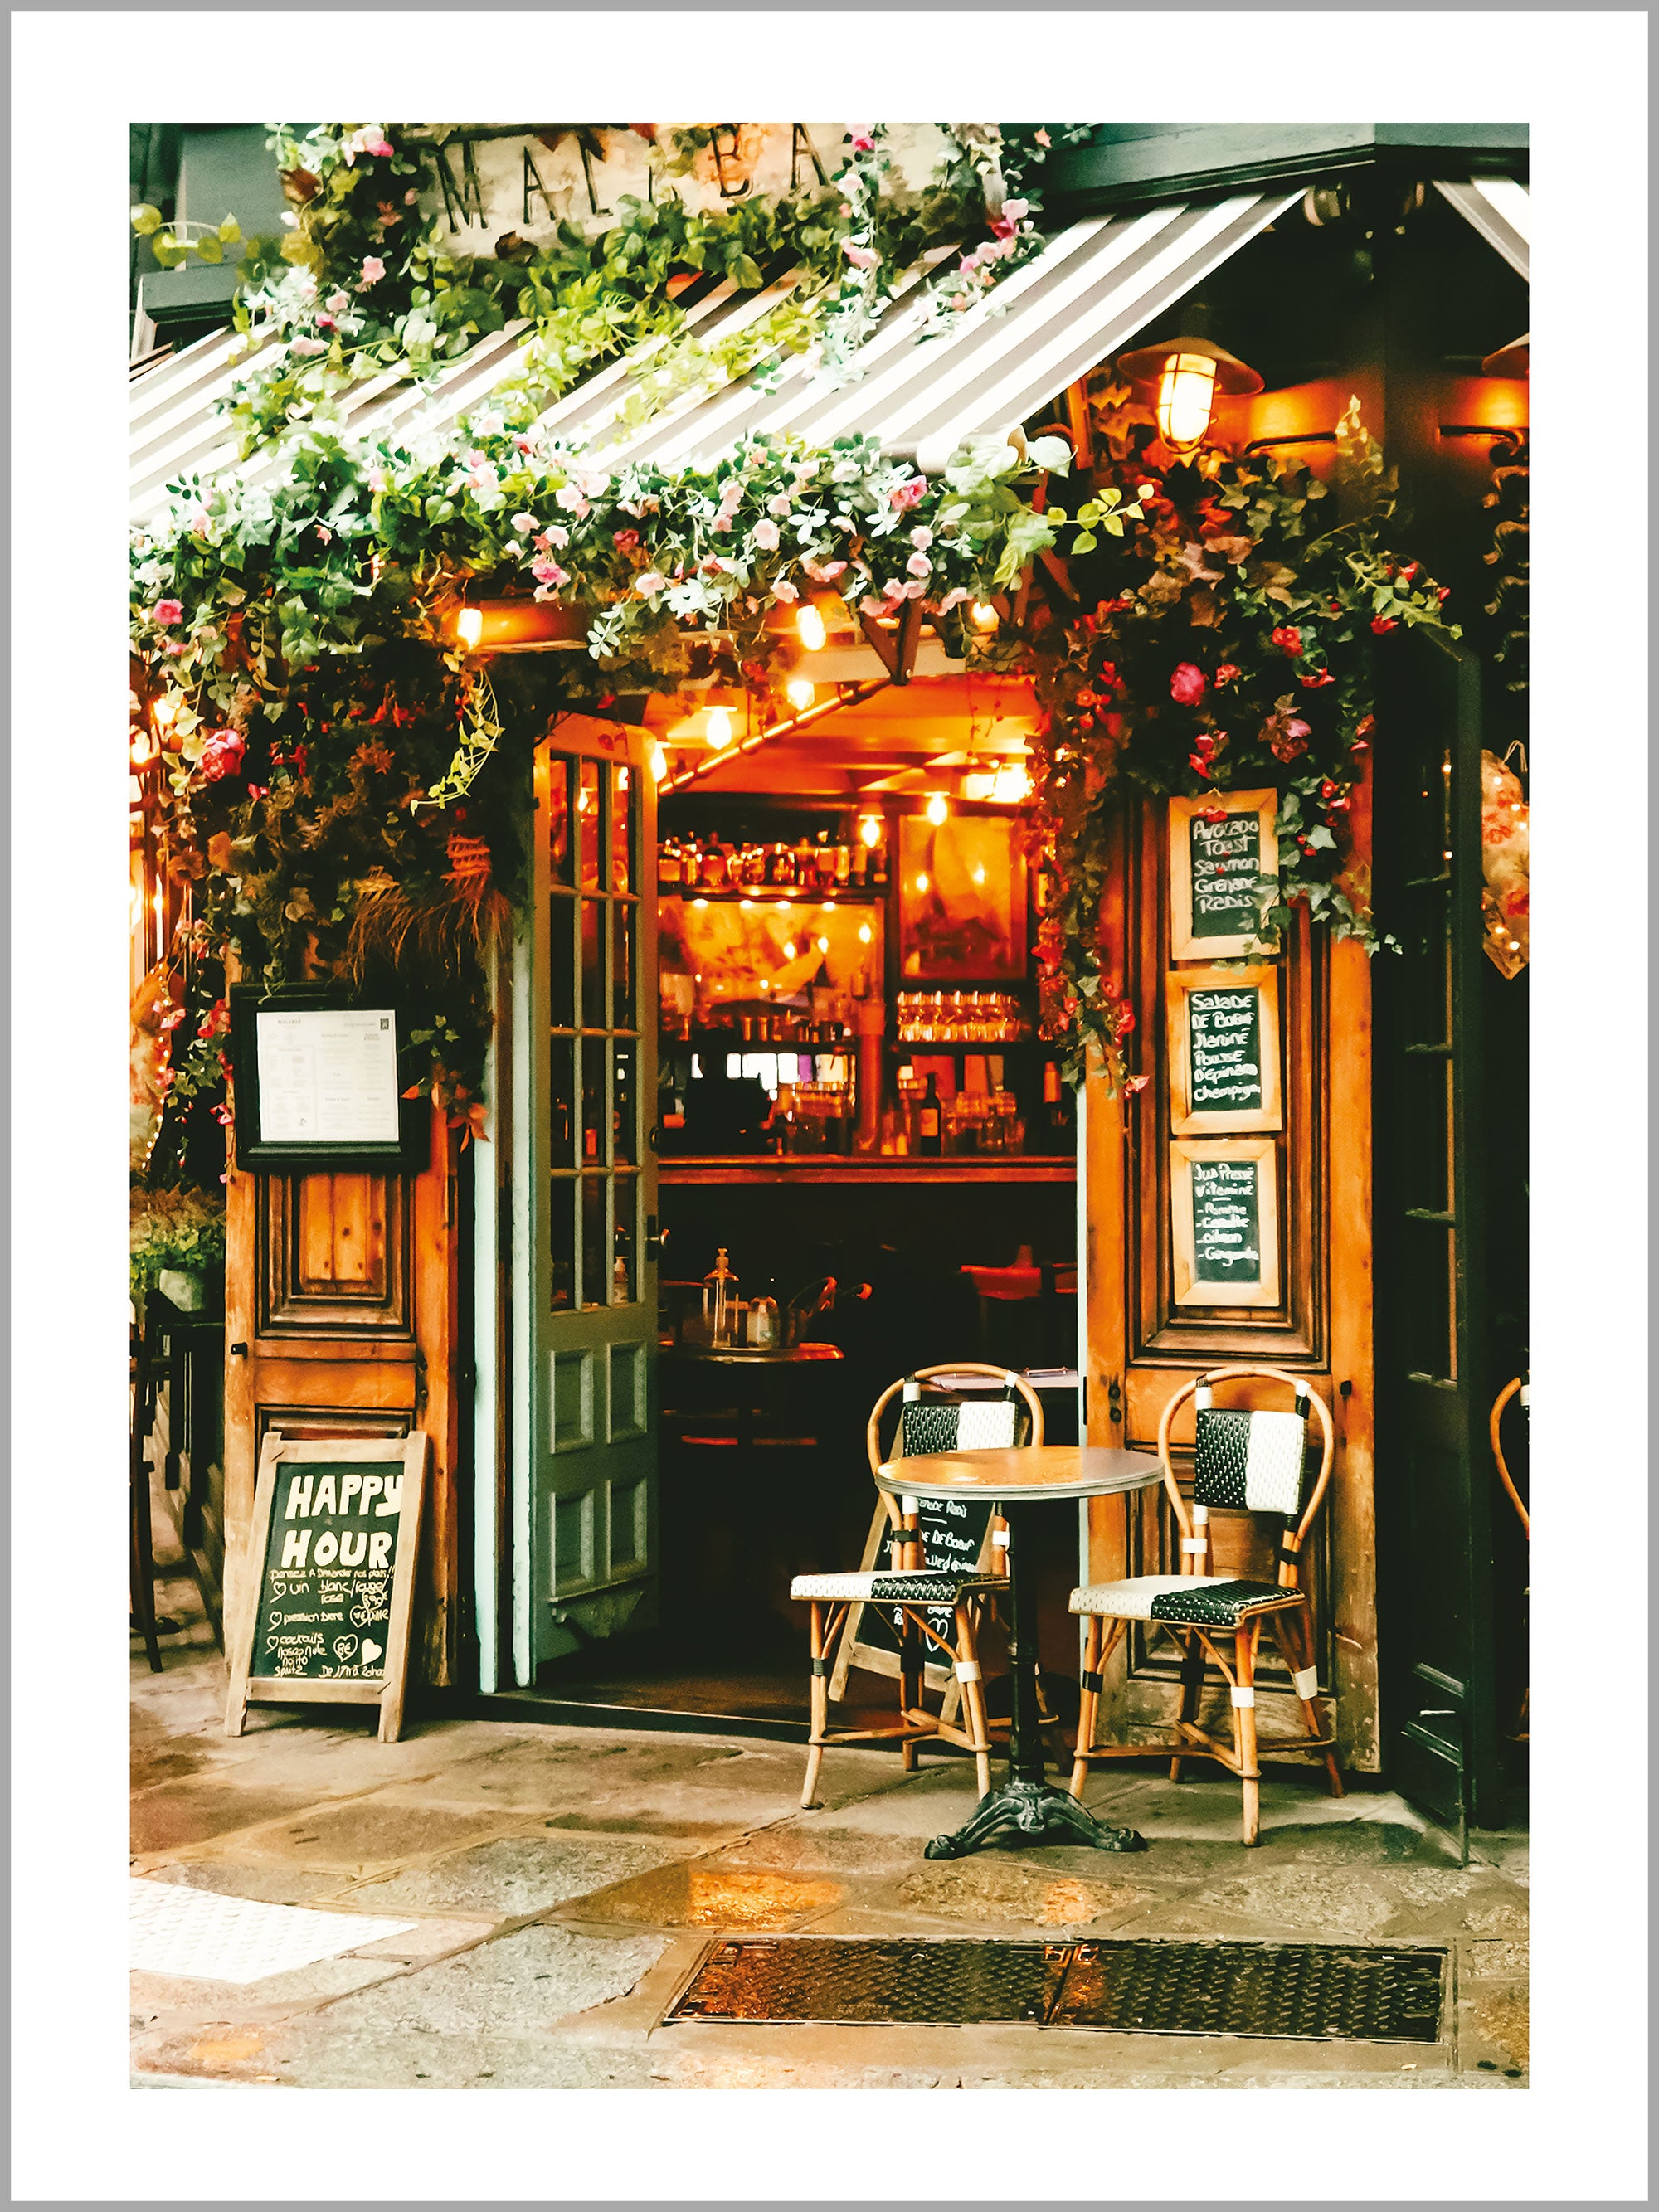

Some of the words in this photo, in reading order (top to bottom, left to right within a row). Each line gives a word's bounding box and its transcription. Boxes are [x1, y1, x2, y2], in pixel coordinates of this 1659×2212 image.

[1192, 1014, 1210, 1029] DE
[285, 1475, 404, 1519] HAPPY
[281, 1529, 392, 1569] HOUR
[289, 1580, 310, 1595] vin
